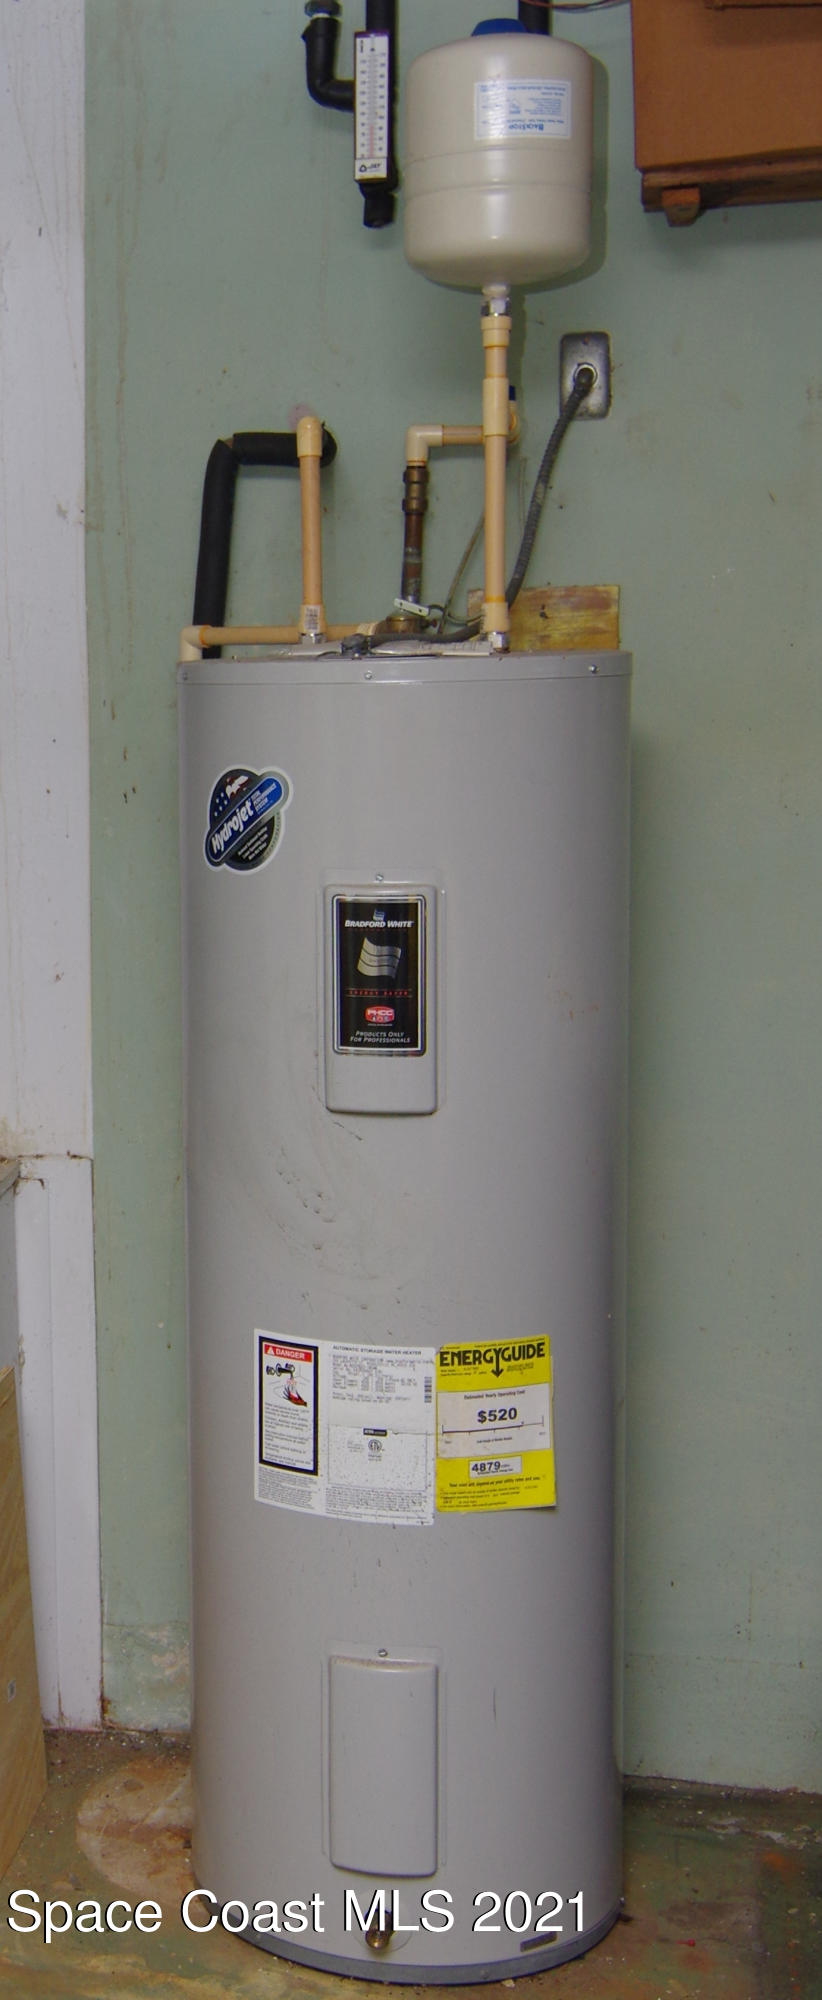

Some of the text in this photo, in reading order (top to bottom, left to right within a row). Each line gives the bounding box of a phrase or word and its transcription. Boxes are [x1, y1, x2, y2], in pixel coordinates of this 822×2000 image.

[211, 800, 254, 854] Hydrojet
[344, 920, 413, 928] BRADFORD WHITE
[363, 1036, 411, 1044] PROFESSIONALS
[275, 1348, 305, 1360] DANGER
[439, 1342, 545, 1375] ENERGYGUIDE
[477, 1407, 518, 1424] $520
[471, 1461, 501, 1473] 4879
